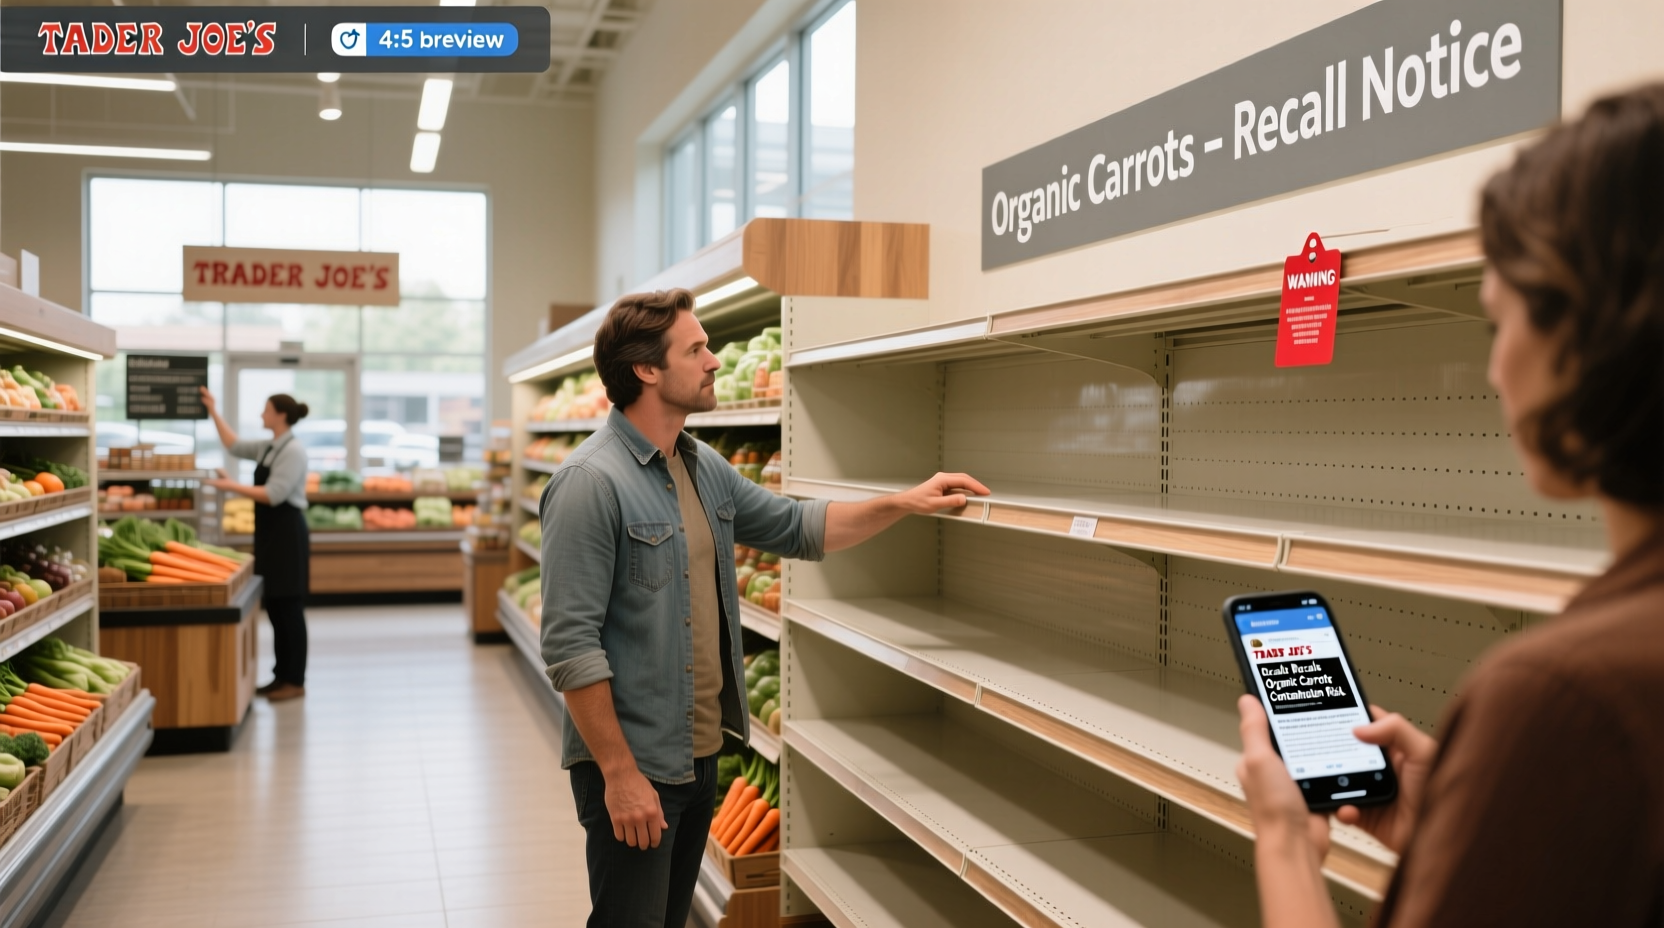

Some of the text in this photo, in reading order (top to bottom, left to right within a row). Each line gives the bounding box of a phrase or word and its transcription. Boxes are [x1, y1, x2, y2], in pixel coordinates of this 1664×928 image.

[991, 164, 1081, 243] Organic
[1087, 130, 1194, 204] Carrots
[1234, 60, 1347, 160] Recall
[1362, 19, 1522, 122] Notice
[194, 261, 389, 290] TRADER JOE'S
